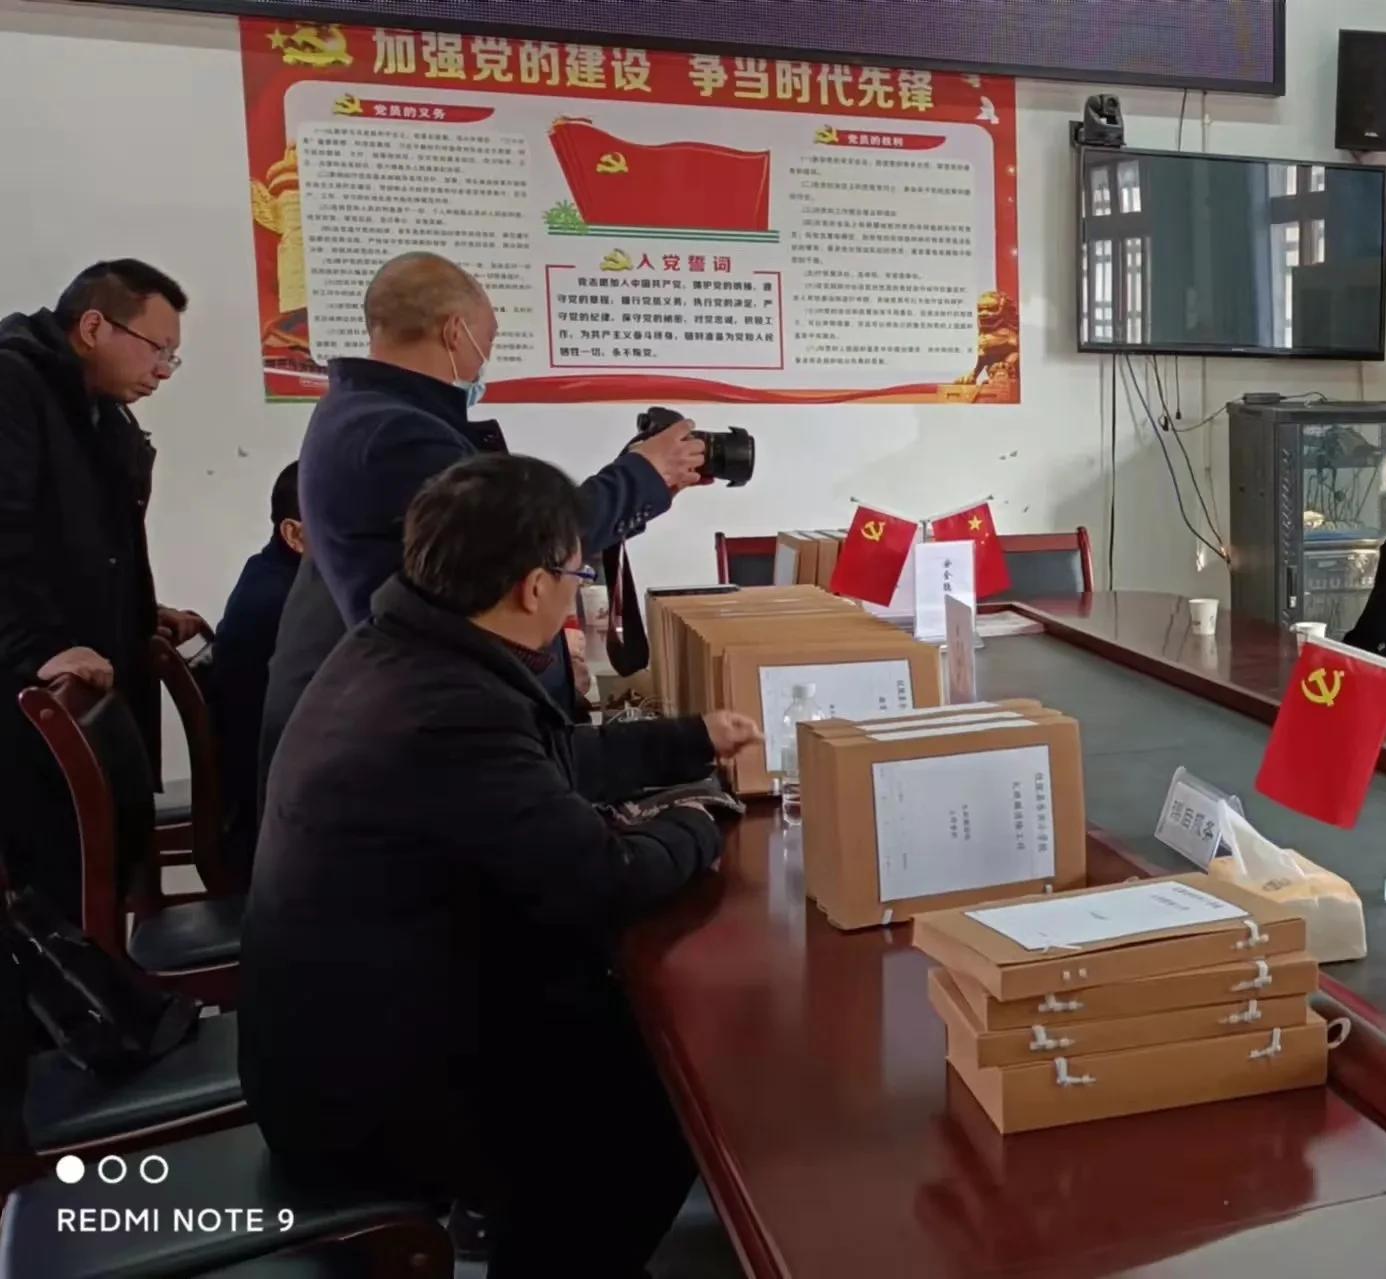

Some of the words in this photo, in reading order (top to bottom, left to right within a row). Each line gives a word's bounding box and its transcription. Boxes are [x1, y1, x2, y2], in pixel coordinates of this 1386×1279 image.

[372, 27, 652, 92] 加强党的建设
[689, 54, 935, 112] 争当时代先锋
[373, 104, 447, 120] 党员的义务
[847, 134, 904, 147] 党员的权利
[636, 253, 732, 273] 入党誓词
